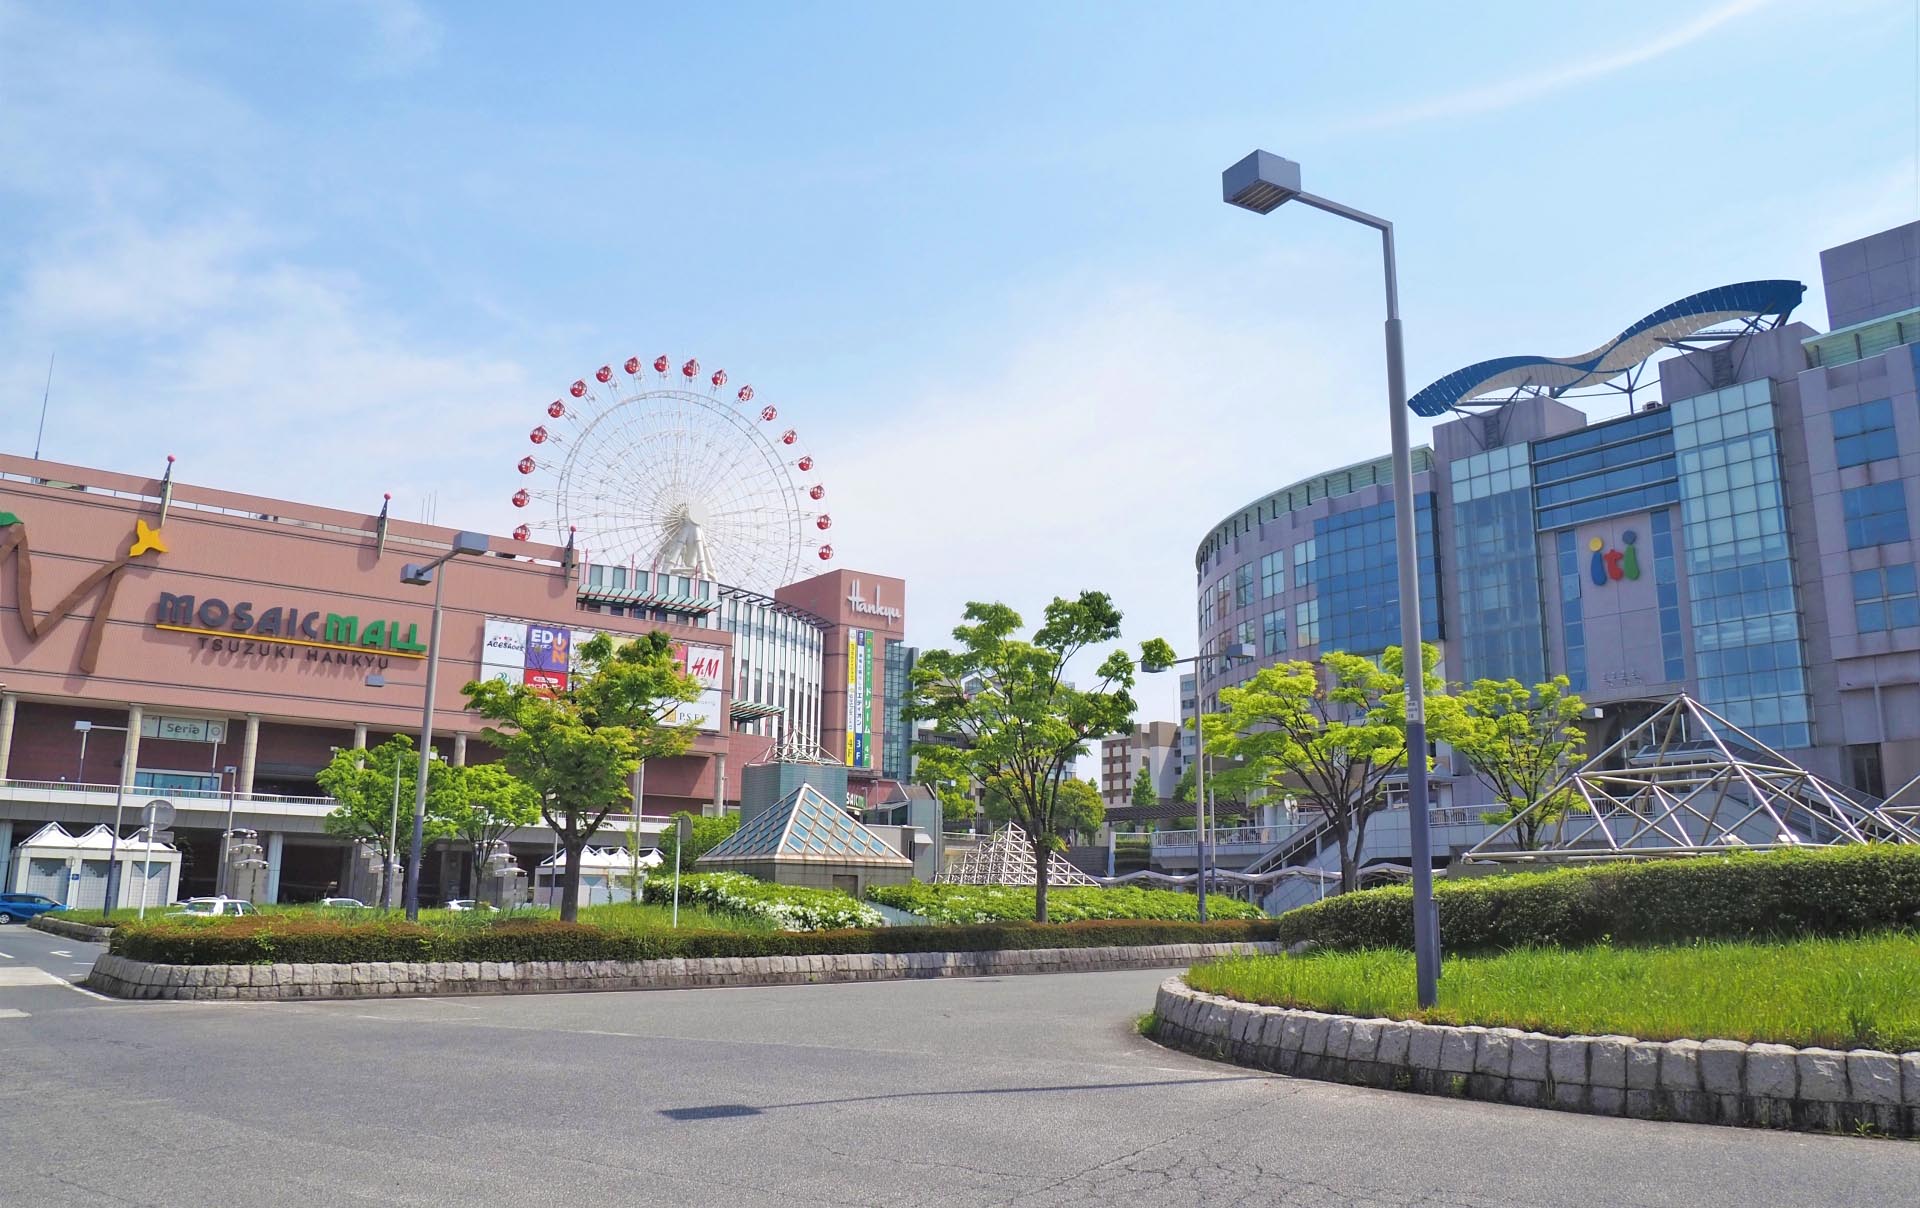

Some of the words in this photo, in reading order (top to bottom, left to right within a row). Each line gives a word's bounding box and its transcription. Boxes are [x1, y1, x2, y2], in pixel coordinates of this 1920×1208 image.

[847, 579, 902, 625] Hankyu
[198, 637, 295, 660] TSUZUKI
[306, 650, 390, 671] HANKYU
[691, 657, 719, 680] H&M
[167, 723, 200, 735] Seria
[856, 739, 862, 760] 3F
